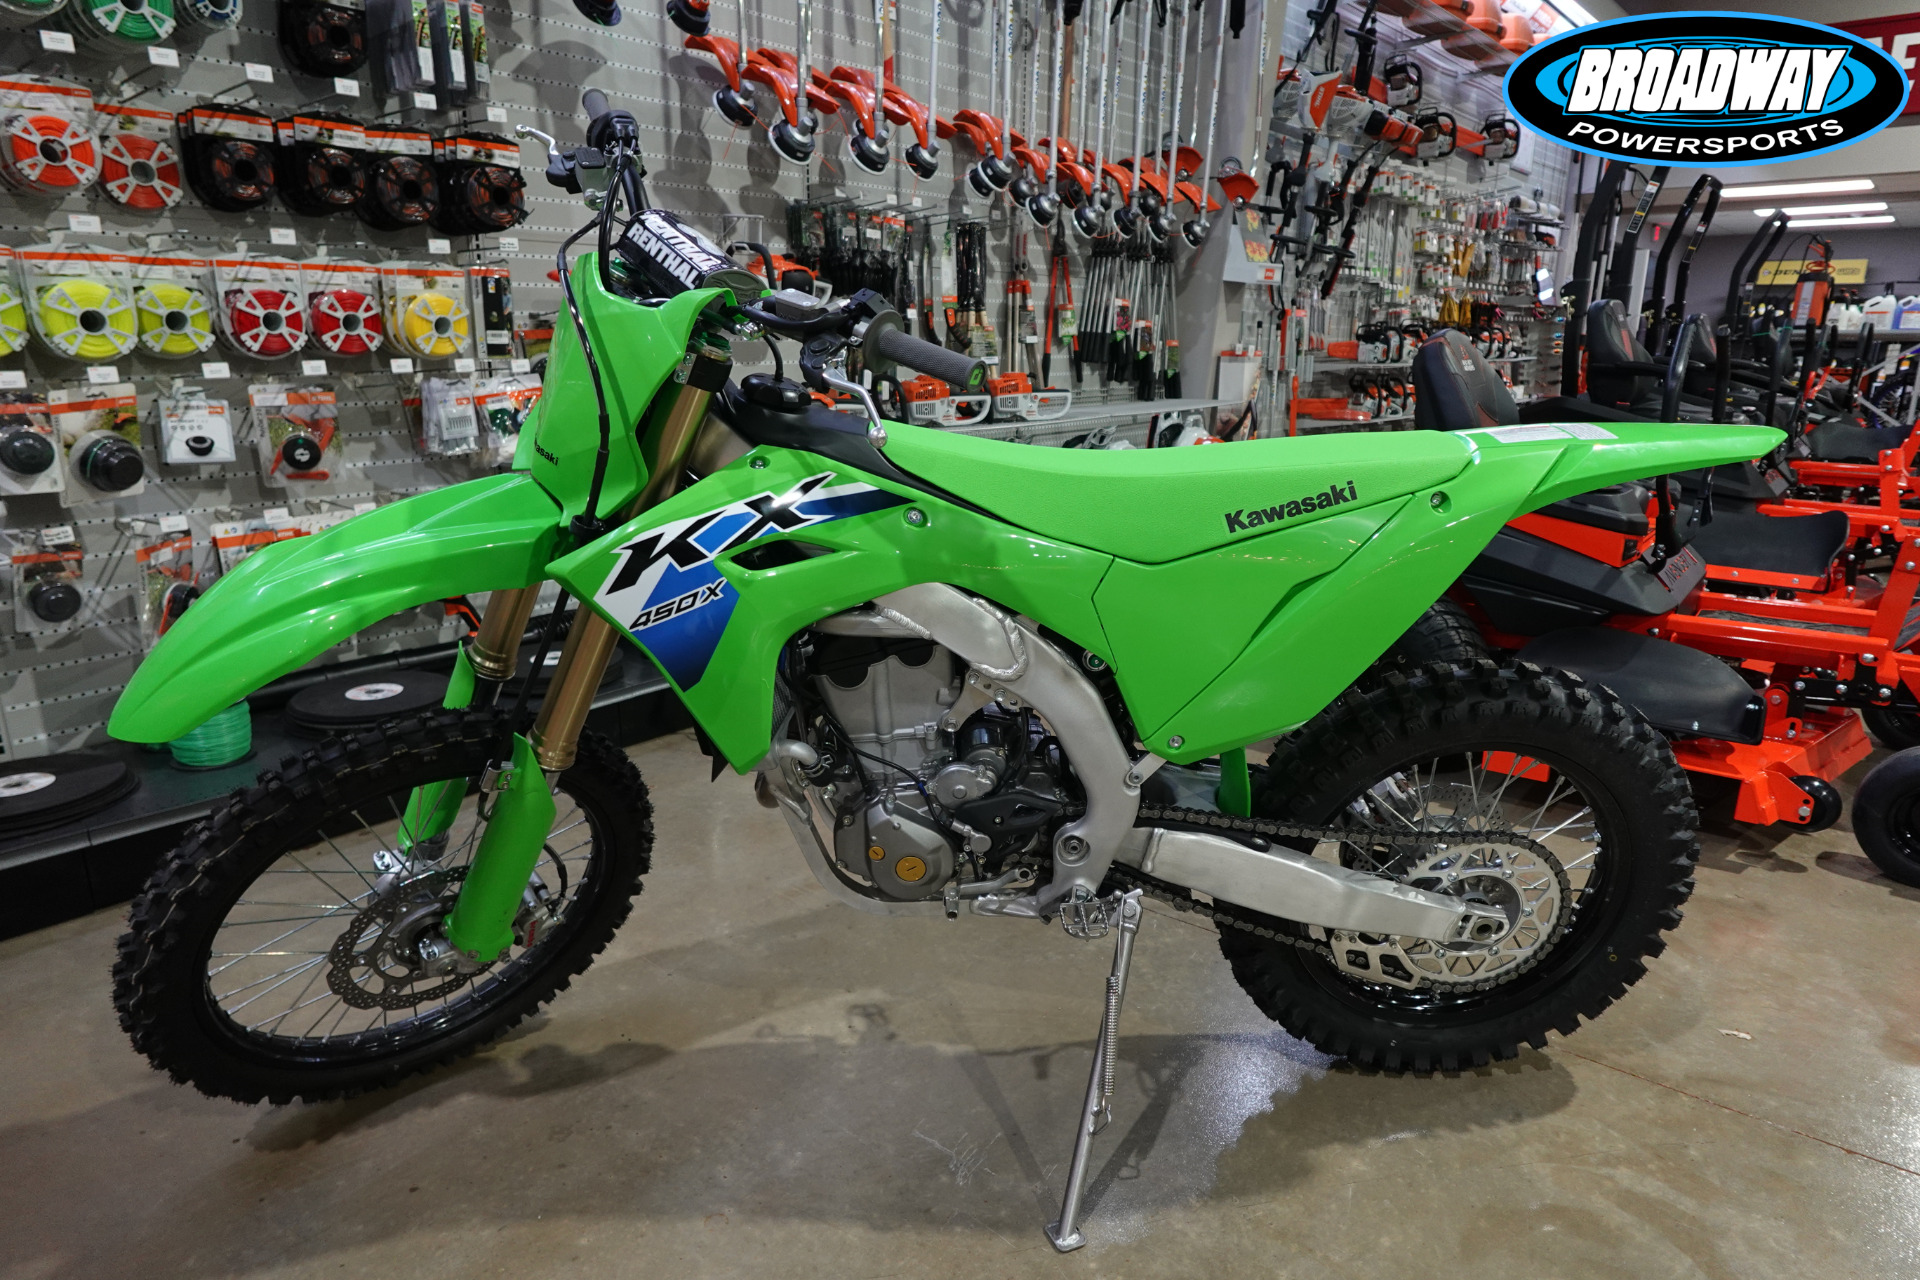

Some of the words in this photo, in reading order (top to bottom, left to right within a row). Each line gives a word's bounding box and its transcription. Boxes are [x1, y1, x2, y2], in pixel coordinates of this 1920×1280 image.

[626, 222, 699, 290] RENTHAL
[535, 440, 559, 466] asaki
[605, 472, 834, 596] KX
[1224, 480, 1358, 534] Kawasaki
[628, 578, 728, 631] 450X
